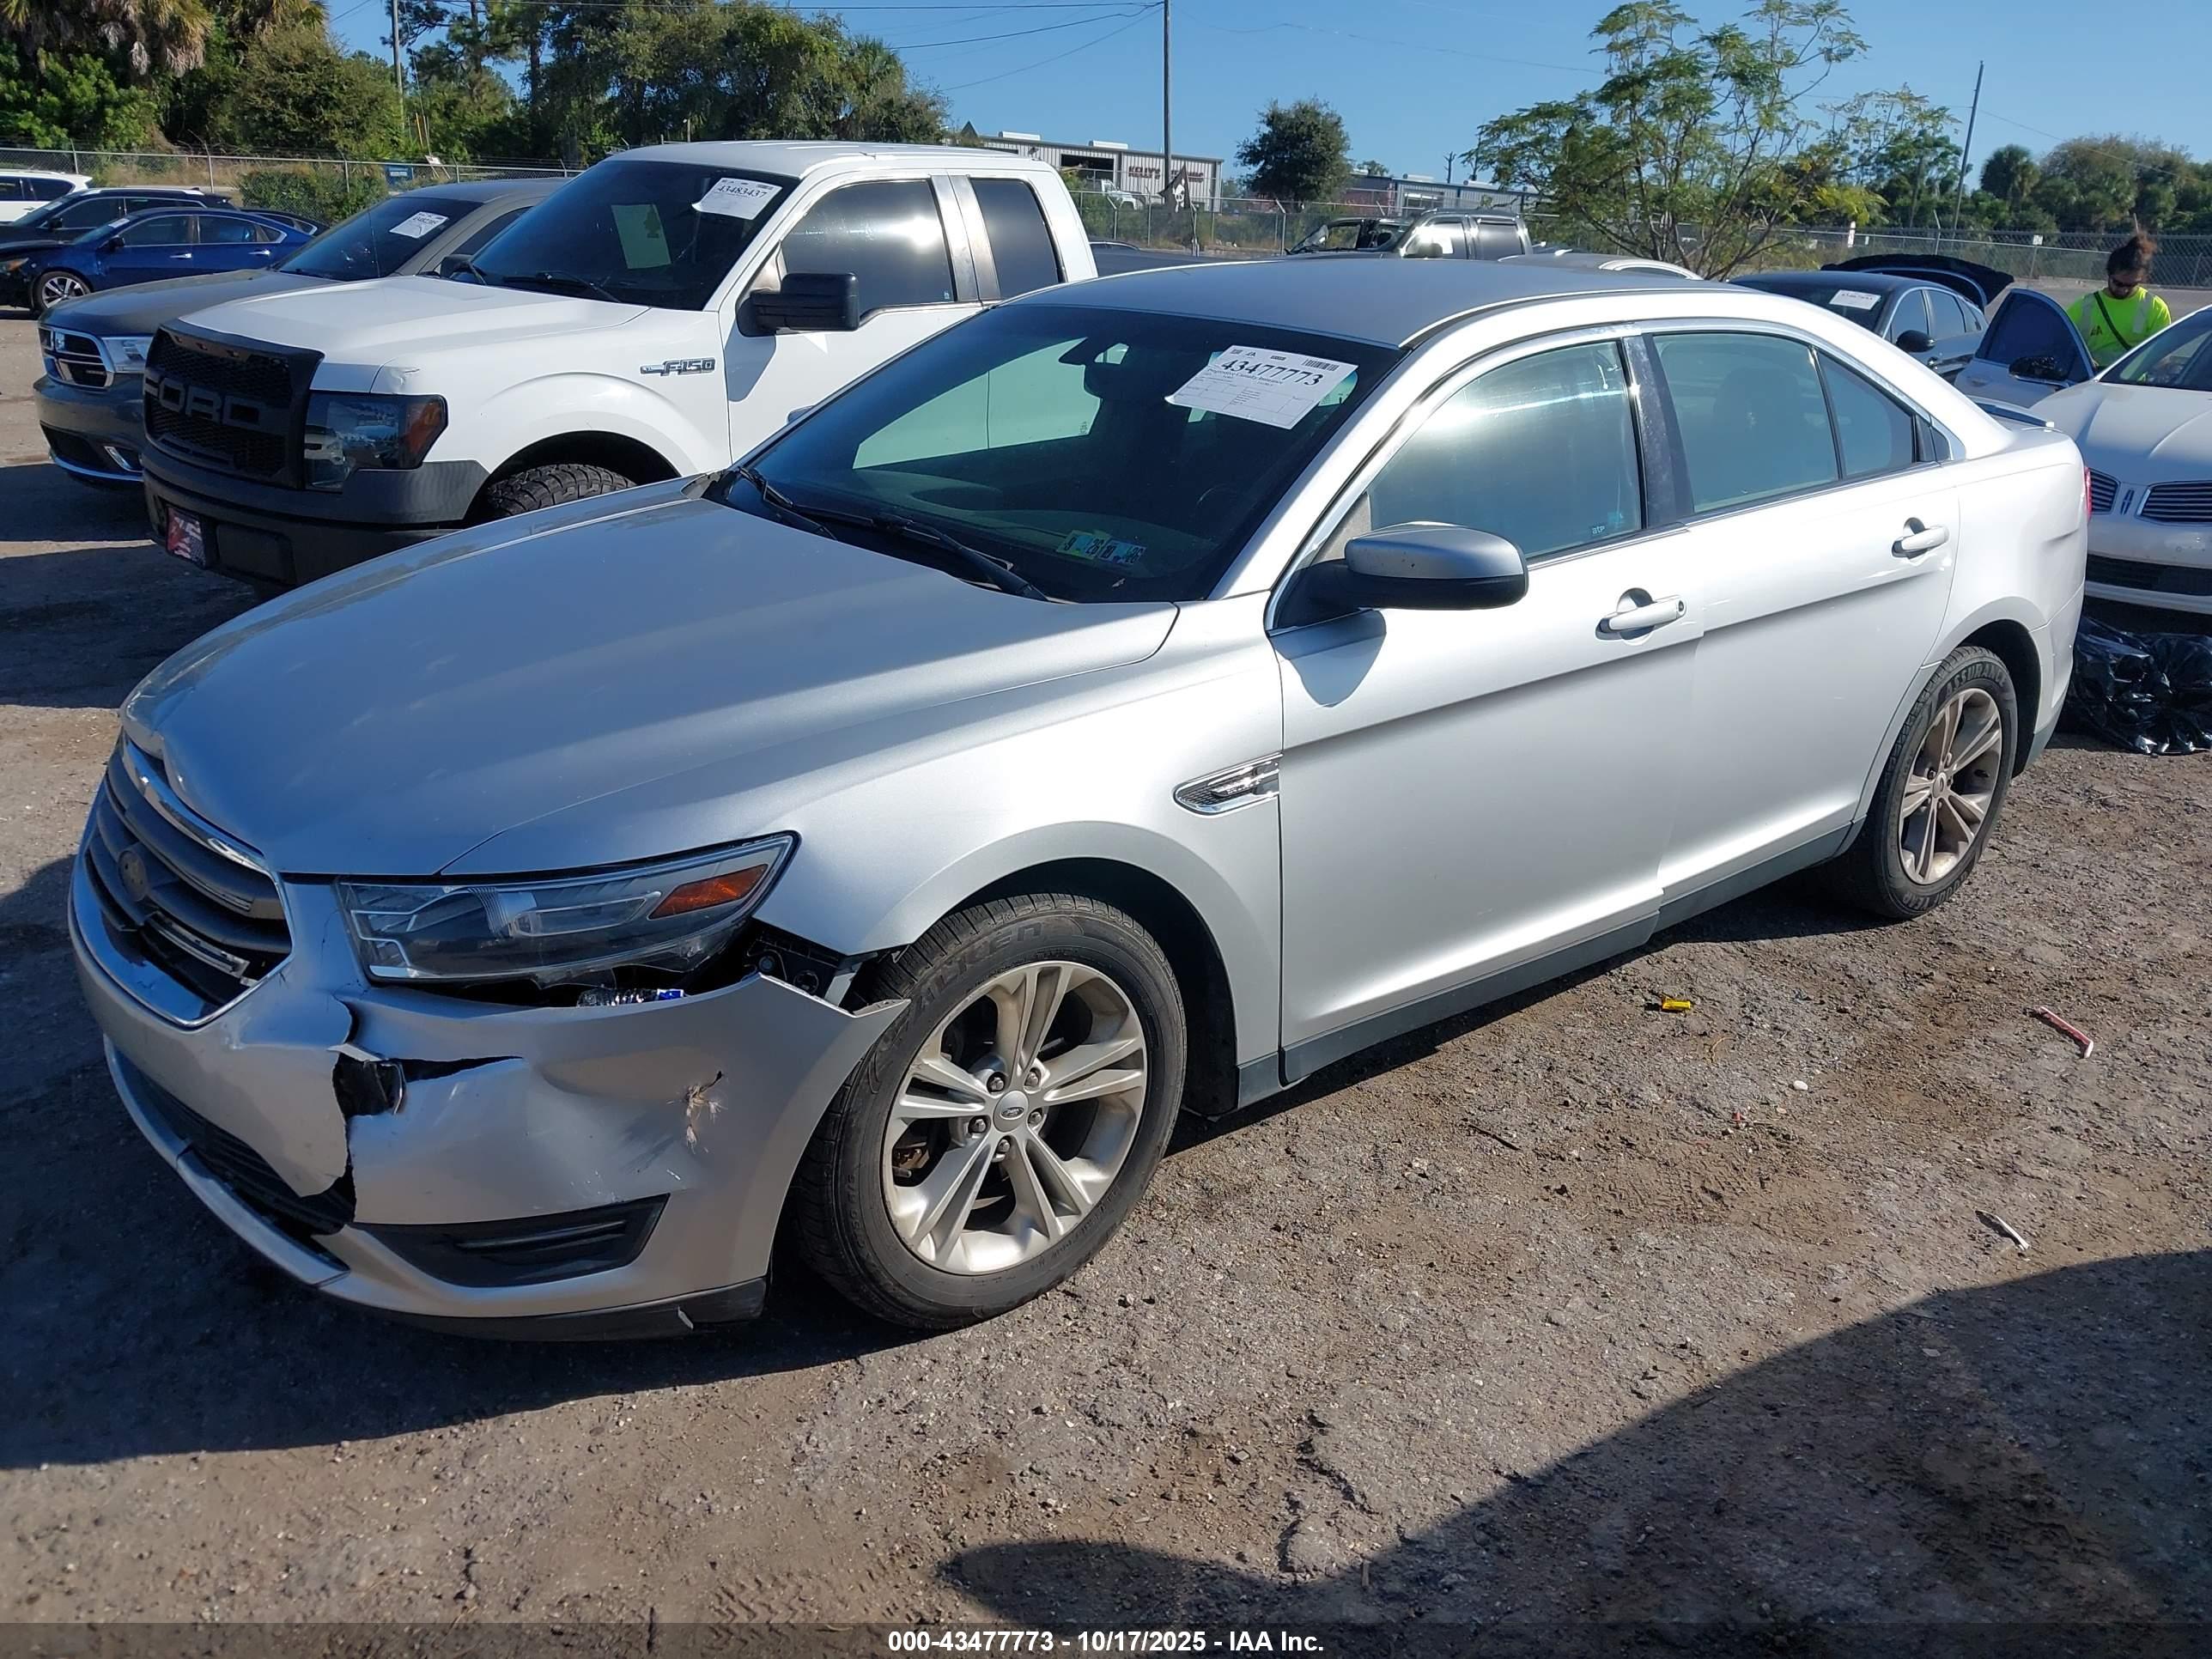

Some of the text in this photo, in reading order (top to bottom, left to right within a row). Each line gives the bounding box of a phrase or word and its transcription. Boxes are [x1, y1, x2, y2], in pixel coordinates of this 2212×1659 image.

[718, 185, 768, 198] 43483437
[1220, 358, 1324, 386] 43477773
[143, 368, 264, 429] FORD
[1945, 662, 2008, 698] ASSURANCE
